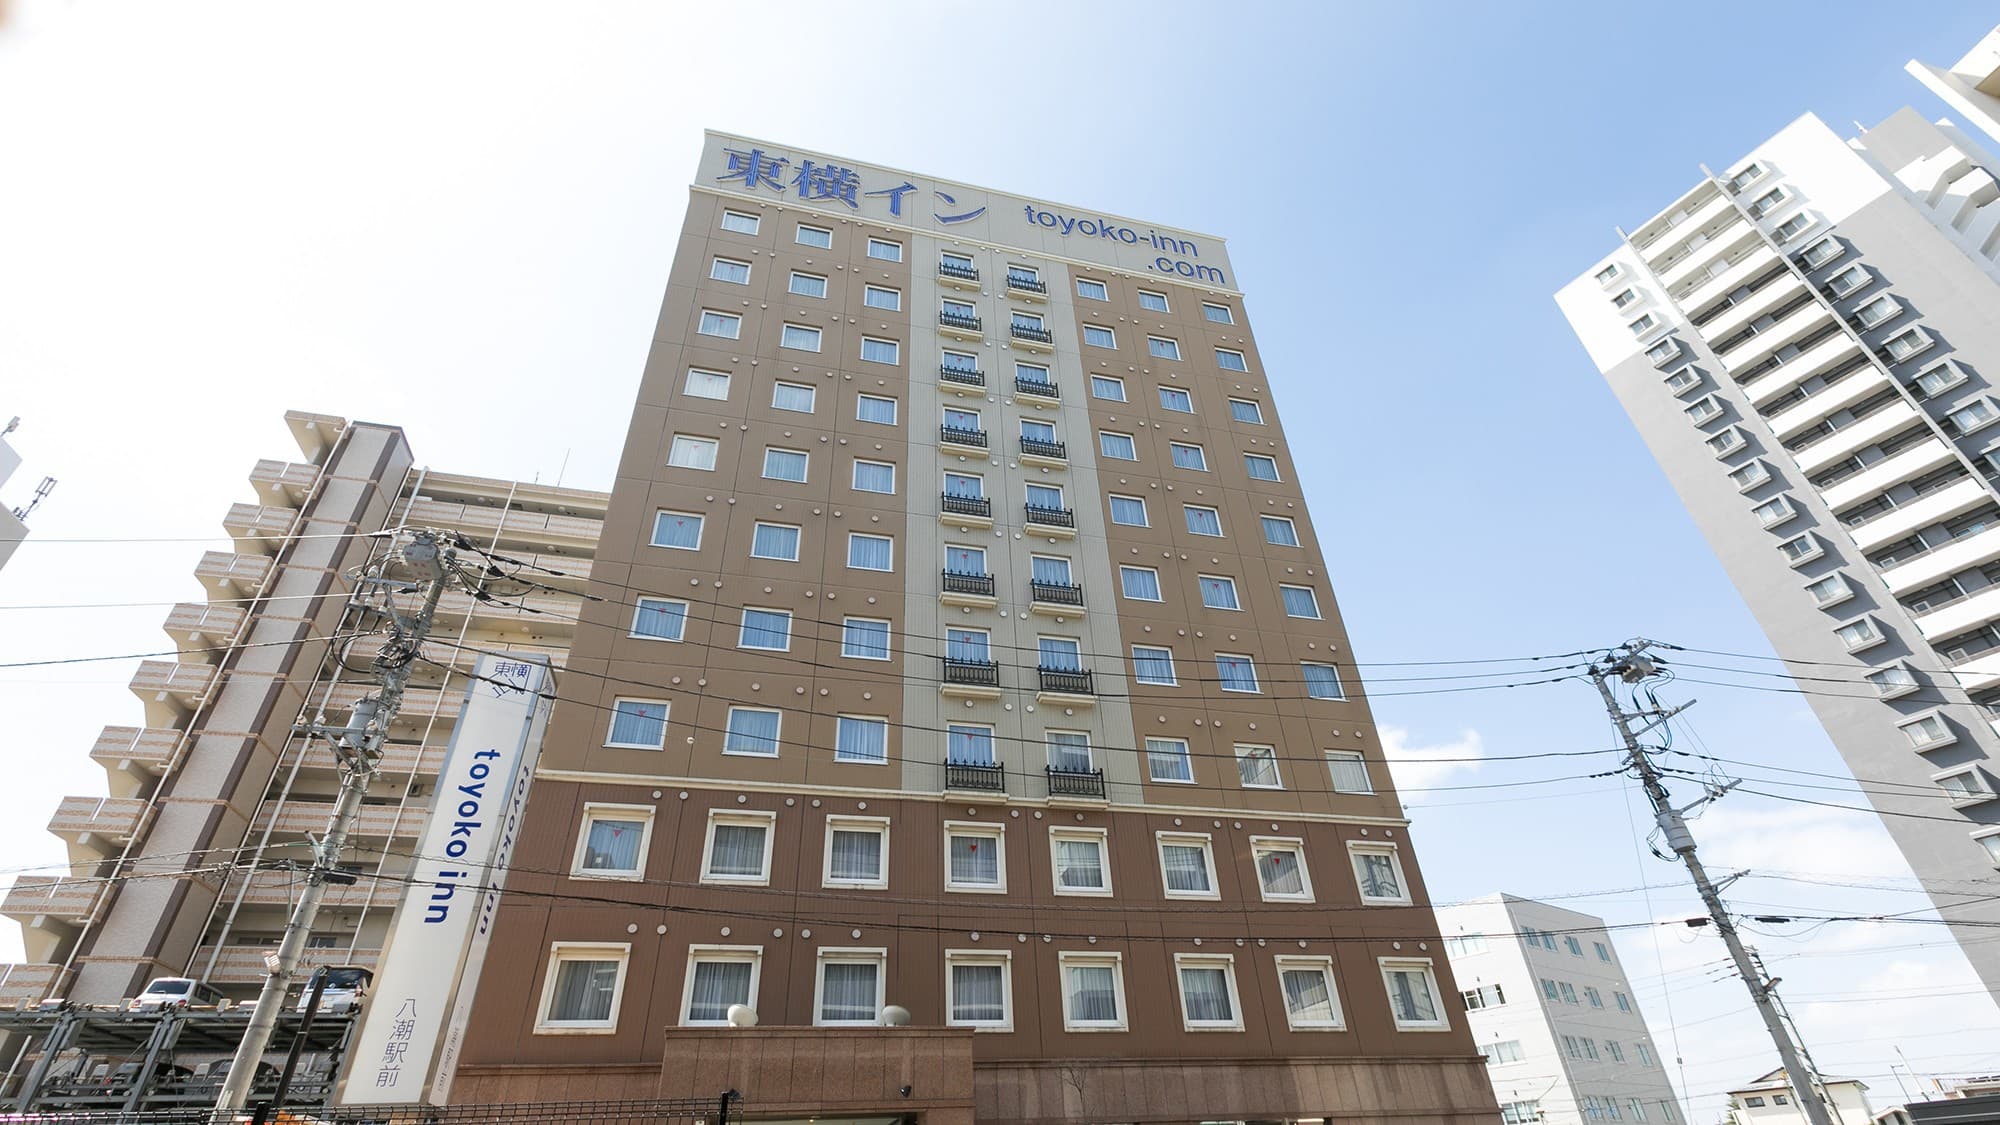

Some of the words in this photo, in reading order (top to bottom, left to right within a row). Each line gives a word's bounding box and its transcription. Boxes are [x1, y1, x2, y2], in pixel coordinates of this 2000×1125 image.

[716, 149, 987, 225] 東横イン
[1024, 204, 1199, 258] toyoko-inn
[1147, 256, 1225, 285] .com
[445, 749, 501, 858] toyoko
[498, 765, 530, 871] toyoko
[424, 871, 468, 924] inn
[376, 998, 417, 1088] 八潮駅前
